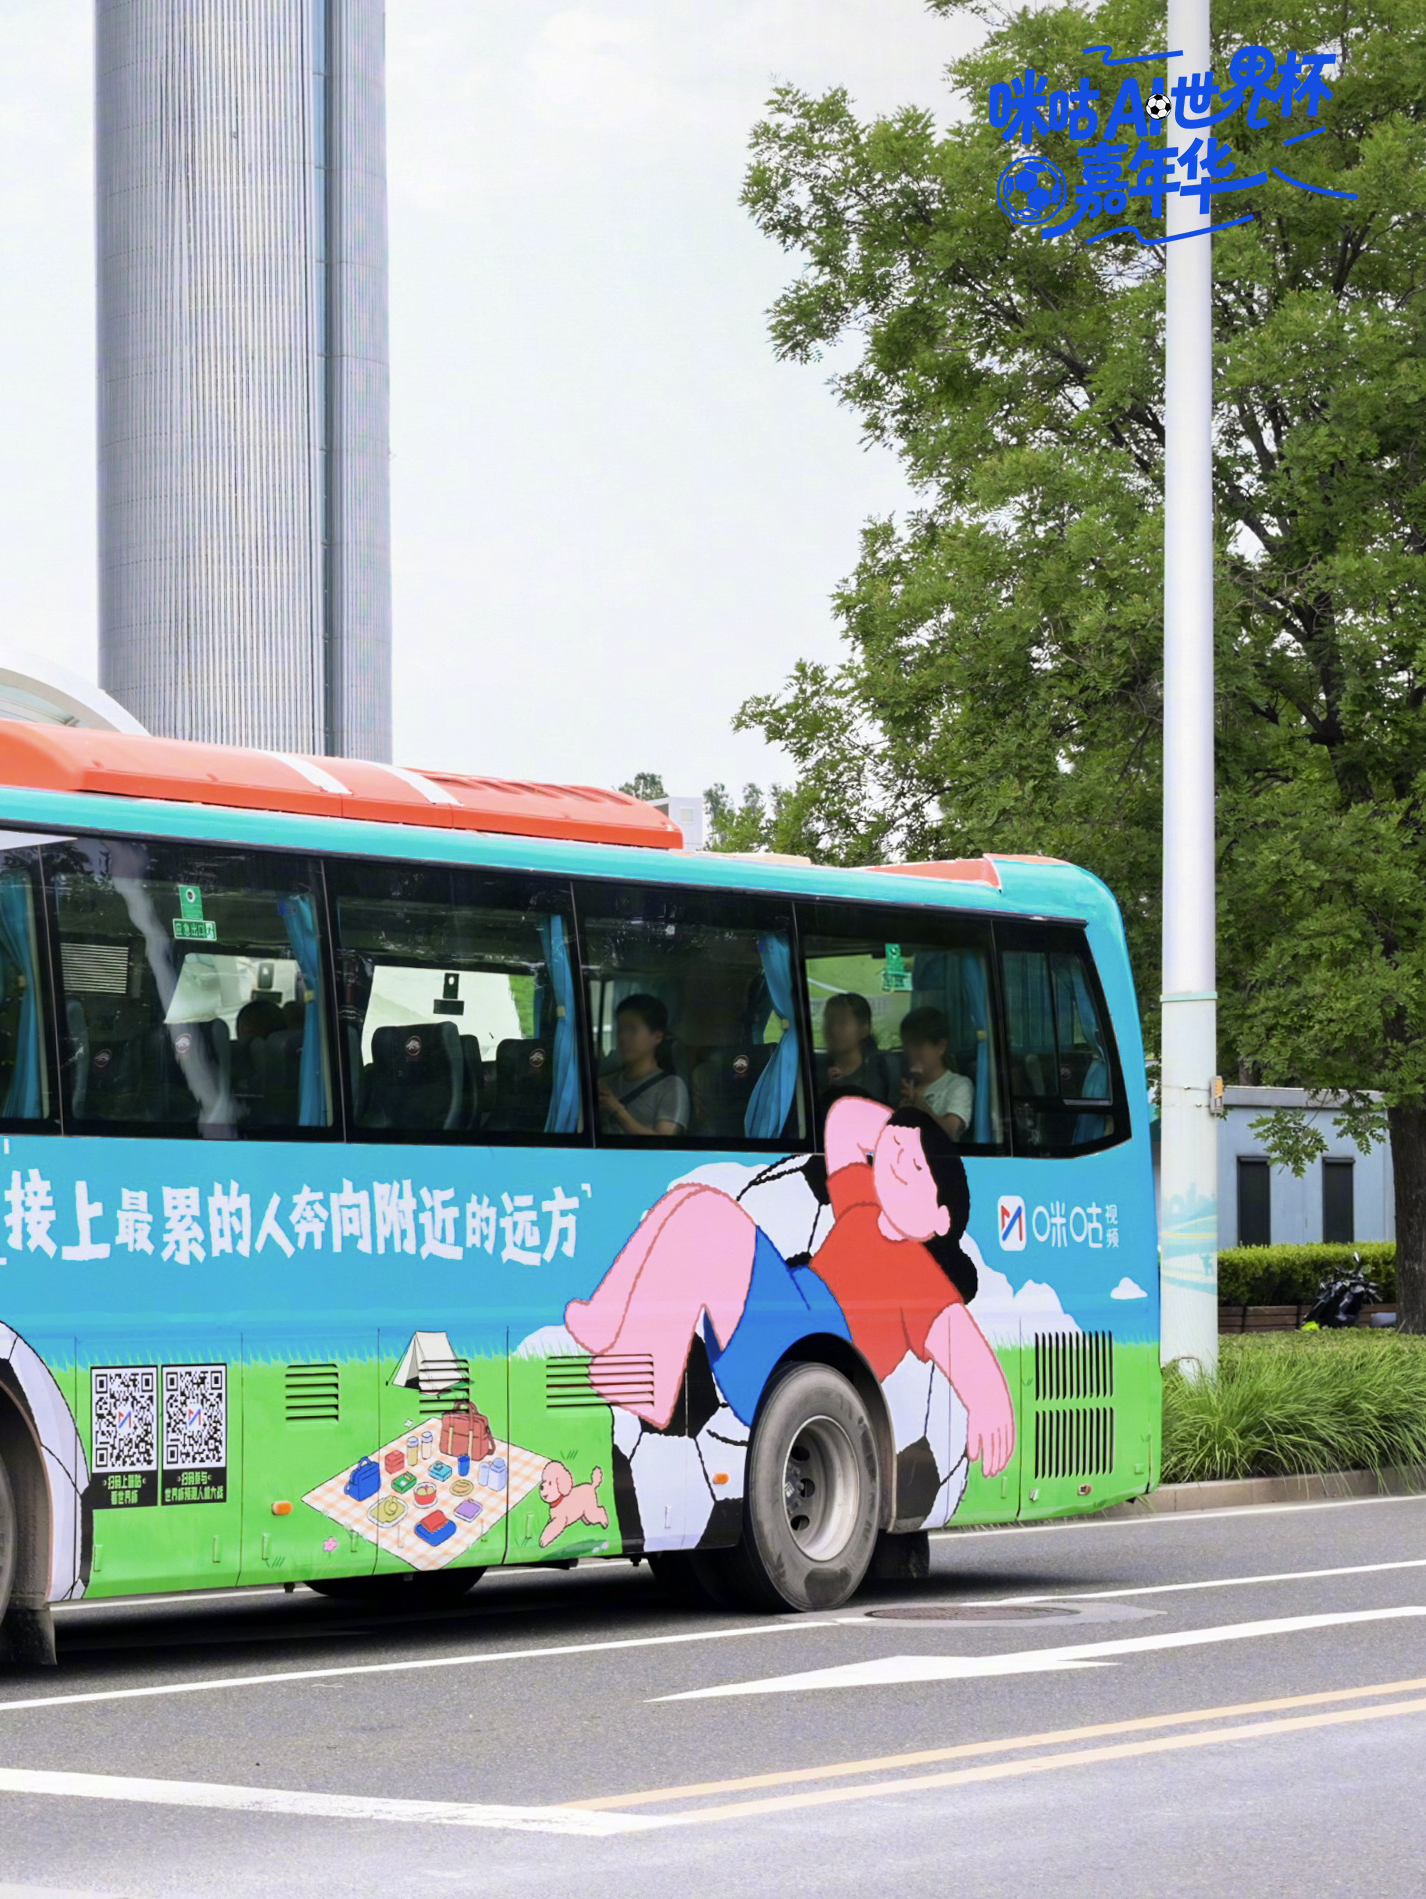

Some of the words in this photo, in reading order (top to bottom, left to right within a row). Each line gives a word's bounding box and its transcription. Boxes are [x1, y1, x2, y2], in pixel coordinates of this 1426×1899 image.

[4, 1169, 579, 1266] 接上最累的人奔向附近的远方
